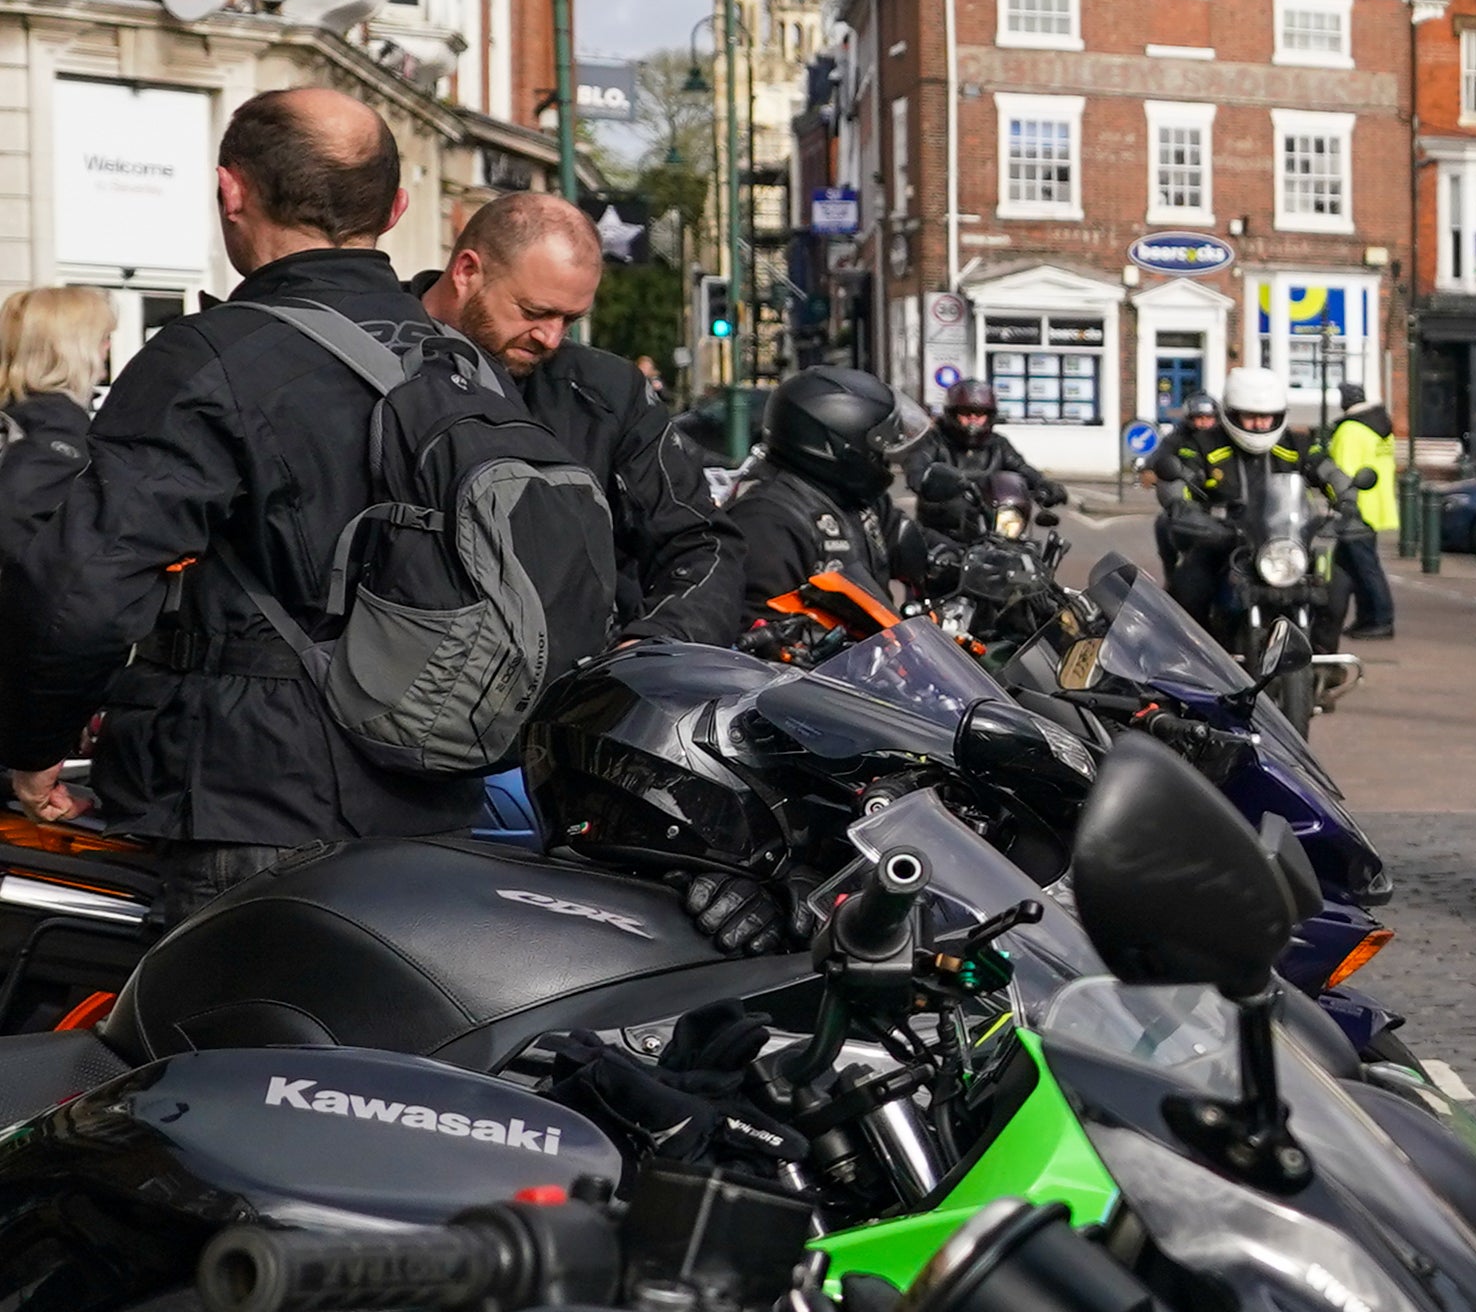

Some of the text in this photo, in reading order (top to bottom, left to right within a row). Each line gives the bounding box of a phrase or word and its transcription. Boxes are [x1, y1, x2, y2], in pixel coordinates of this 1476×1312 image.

[83, 152, 175, 177] Welcome
[496, 888, 655, 941] CBR
[265, 1076, 562, 1155] Kawasaki
